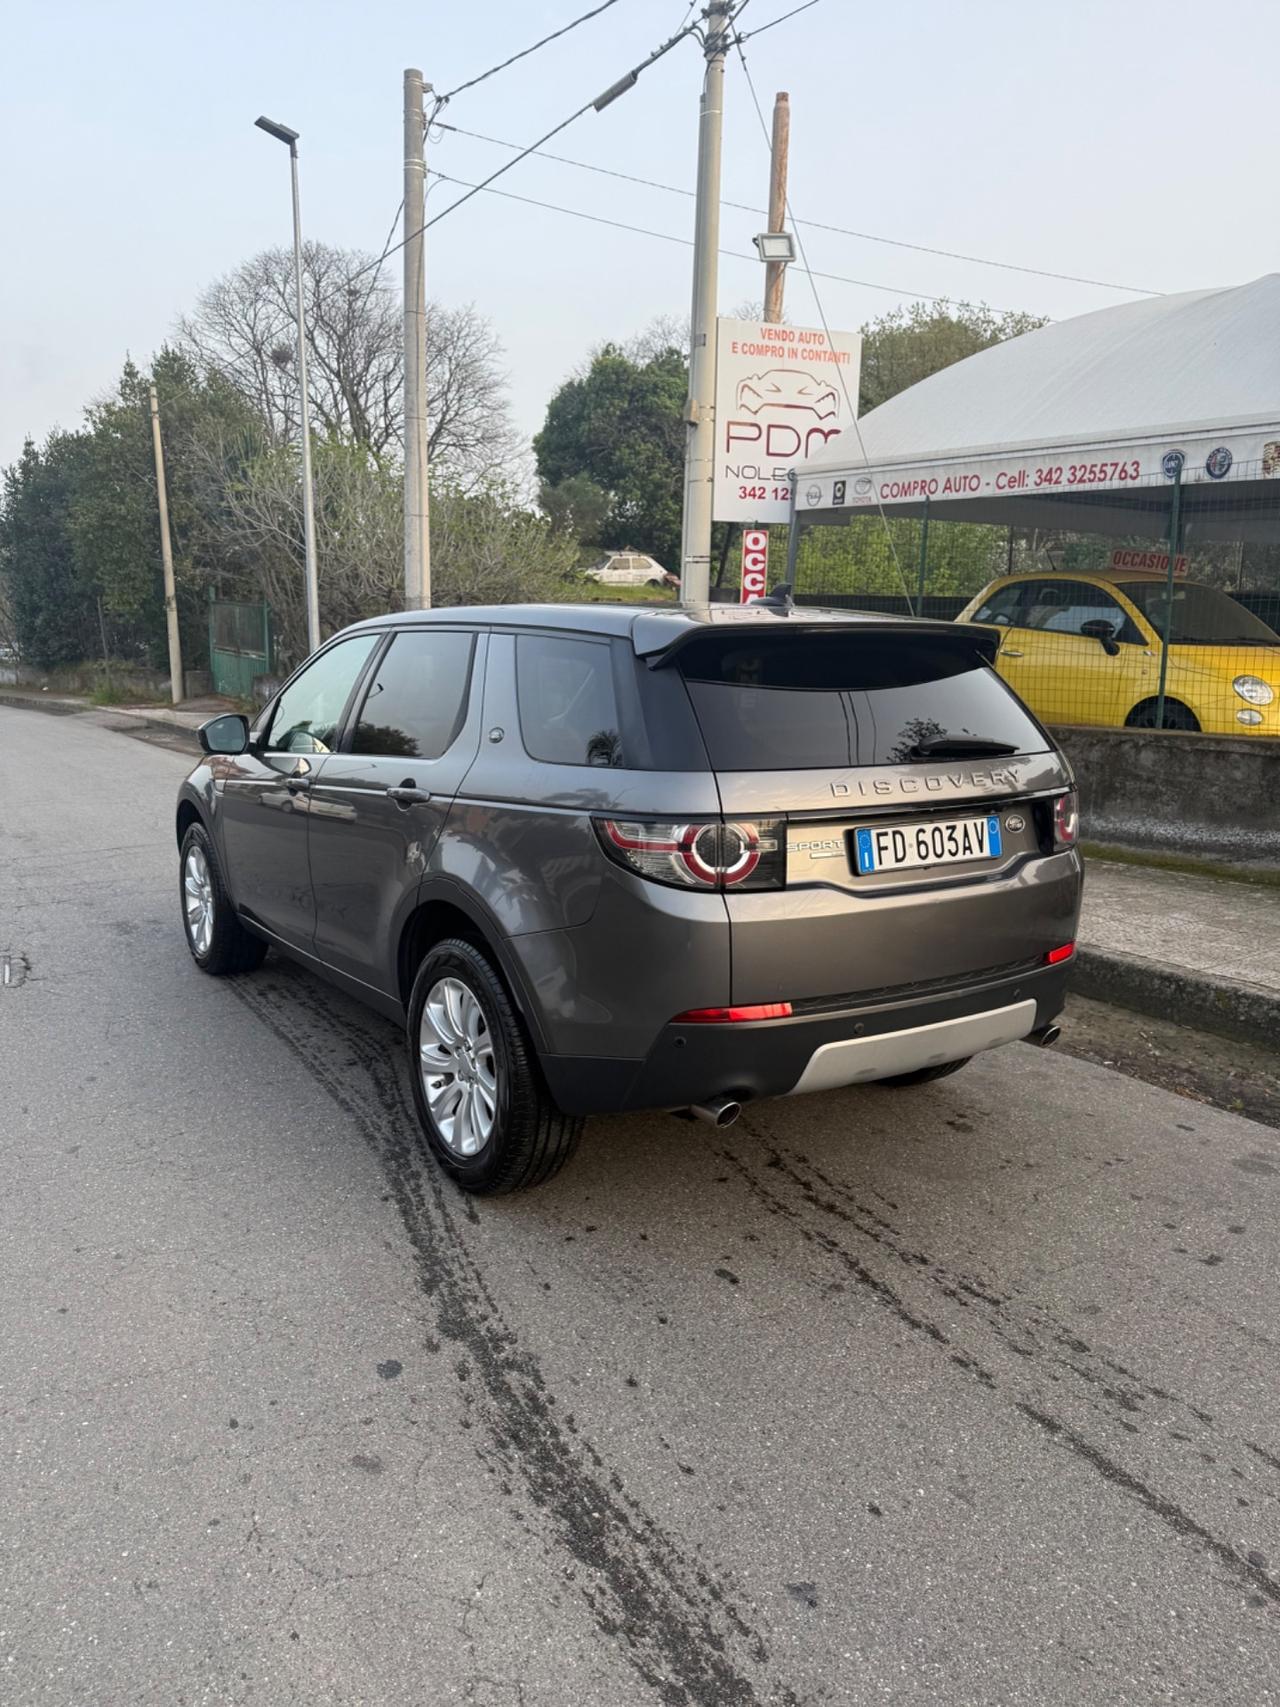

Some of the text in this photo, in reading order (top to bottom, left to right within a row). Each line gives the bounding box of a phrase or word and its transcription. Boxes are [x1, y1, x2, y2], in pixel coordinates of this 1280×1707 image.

[761, 327, 826, 345] VENDO AUTO
[731, 341, 851, 365] E COMPRO IN CONTANTI
[880, 478, 939, 499] COMPRO
[942, 474, 981, 494] AUTO
[995, 470, 1030, 490] Cell:
[1034, 466, 1063, 487] 342
[1067, 460, 1140, 484] 3255763
[739, 486, 766, 500] 342
[831, 768, 1020, 798] DISCOVERY
[786, 839, 845, 853] SPORT
[876, 821, 985, 865] FD 603AV
